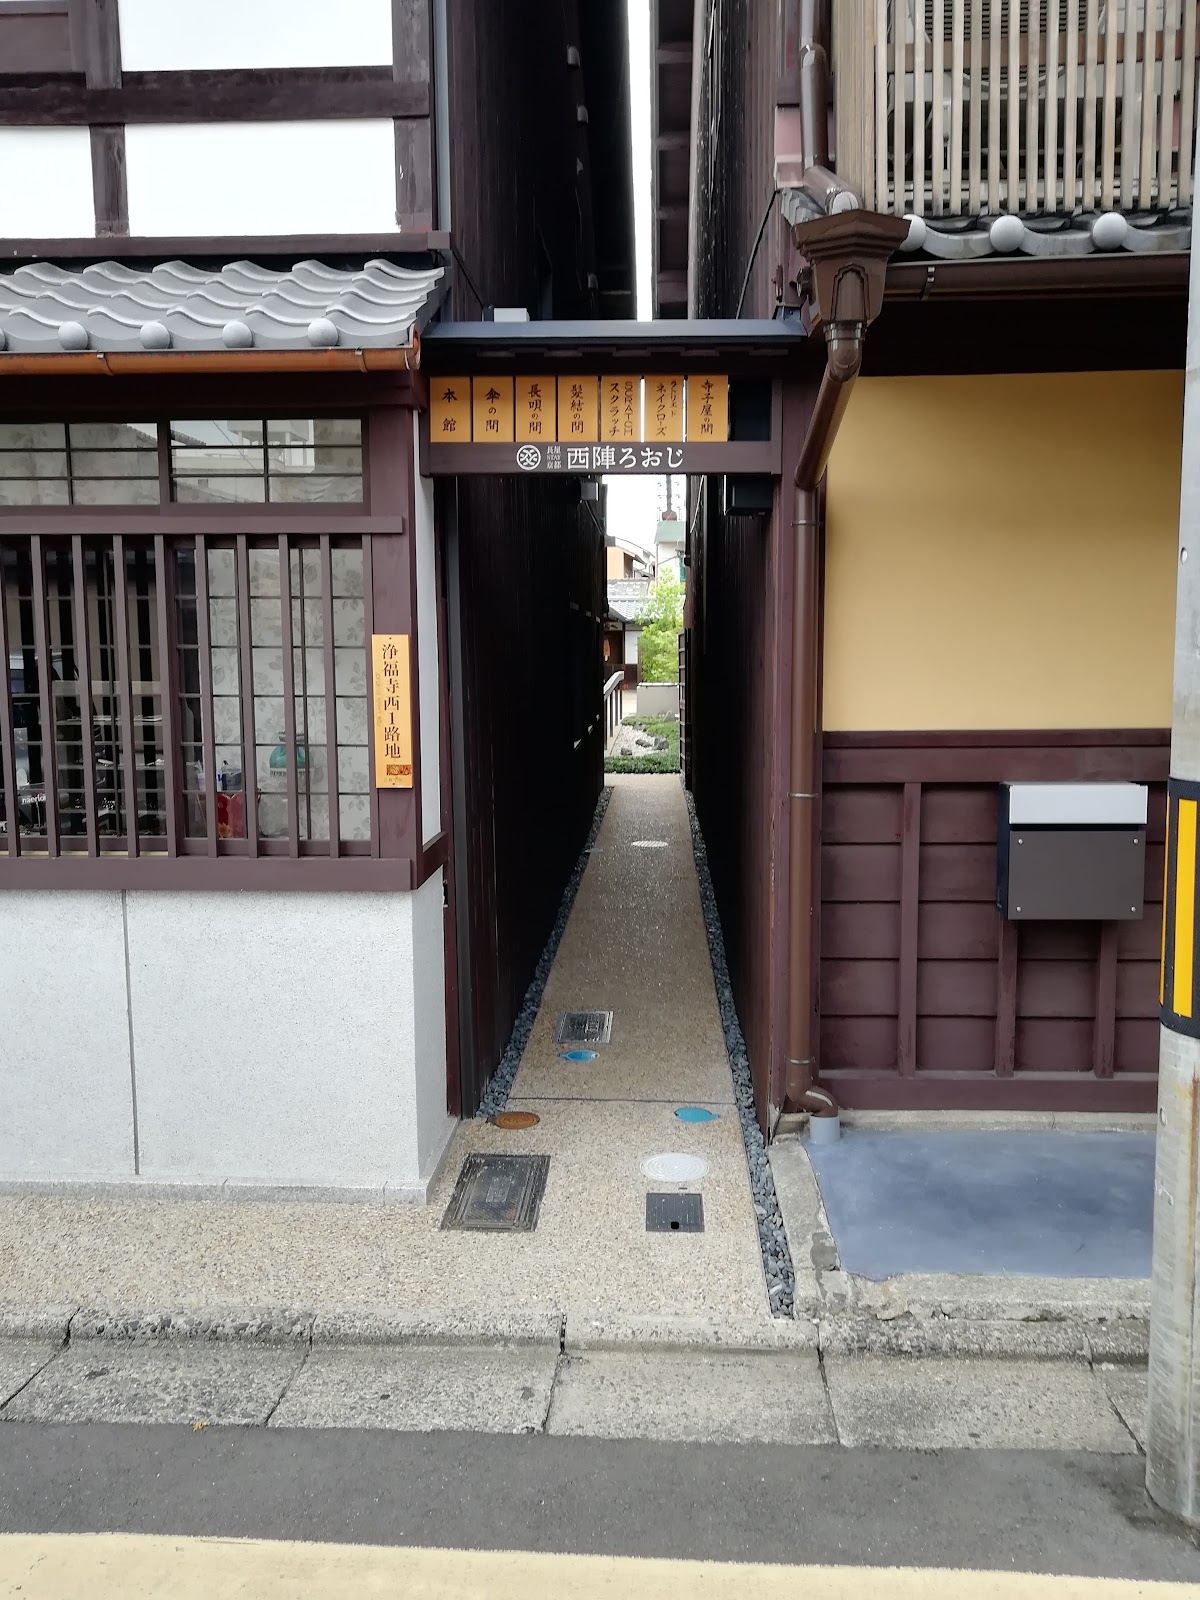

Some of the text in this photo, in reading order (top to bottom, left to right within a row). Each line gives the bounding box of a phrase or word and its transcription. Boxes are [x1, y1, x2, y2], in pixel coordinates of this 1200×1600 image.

[442, 387, 458, 433] 本館
[485, 387, 501, 433] 傘の間
[528, 383, 542, 434] 長唄の間
[609, 382, 620, 437] スクラッチ
[624, 381, 633, 436] SCRATCH
[656, 383, 667, 437] ネイクローズ
[700, 379, 714, 435] 寺子屋の間
[567, 446, 683, 470] 西陣ろおじ
[381, 643, 401, 759] 浄福寺西1路地
